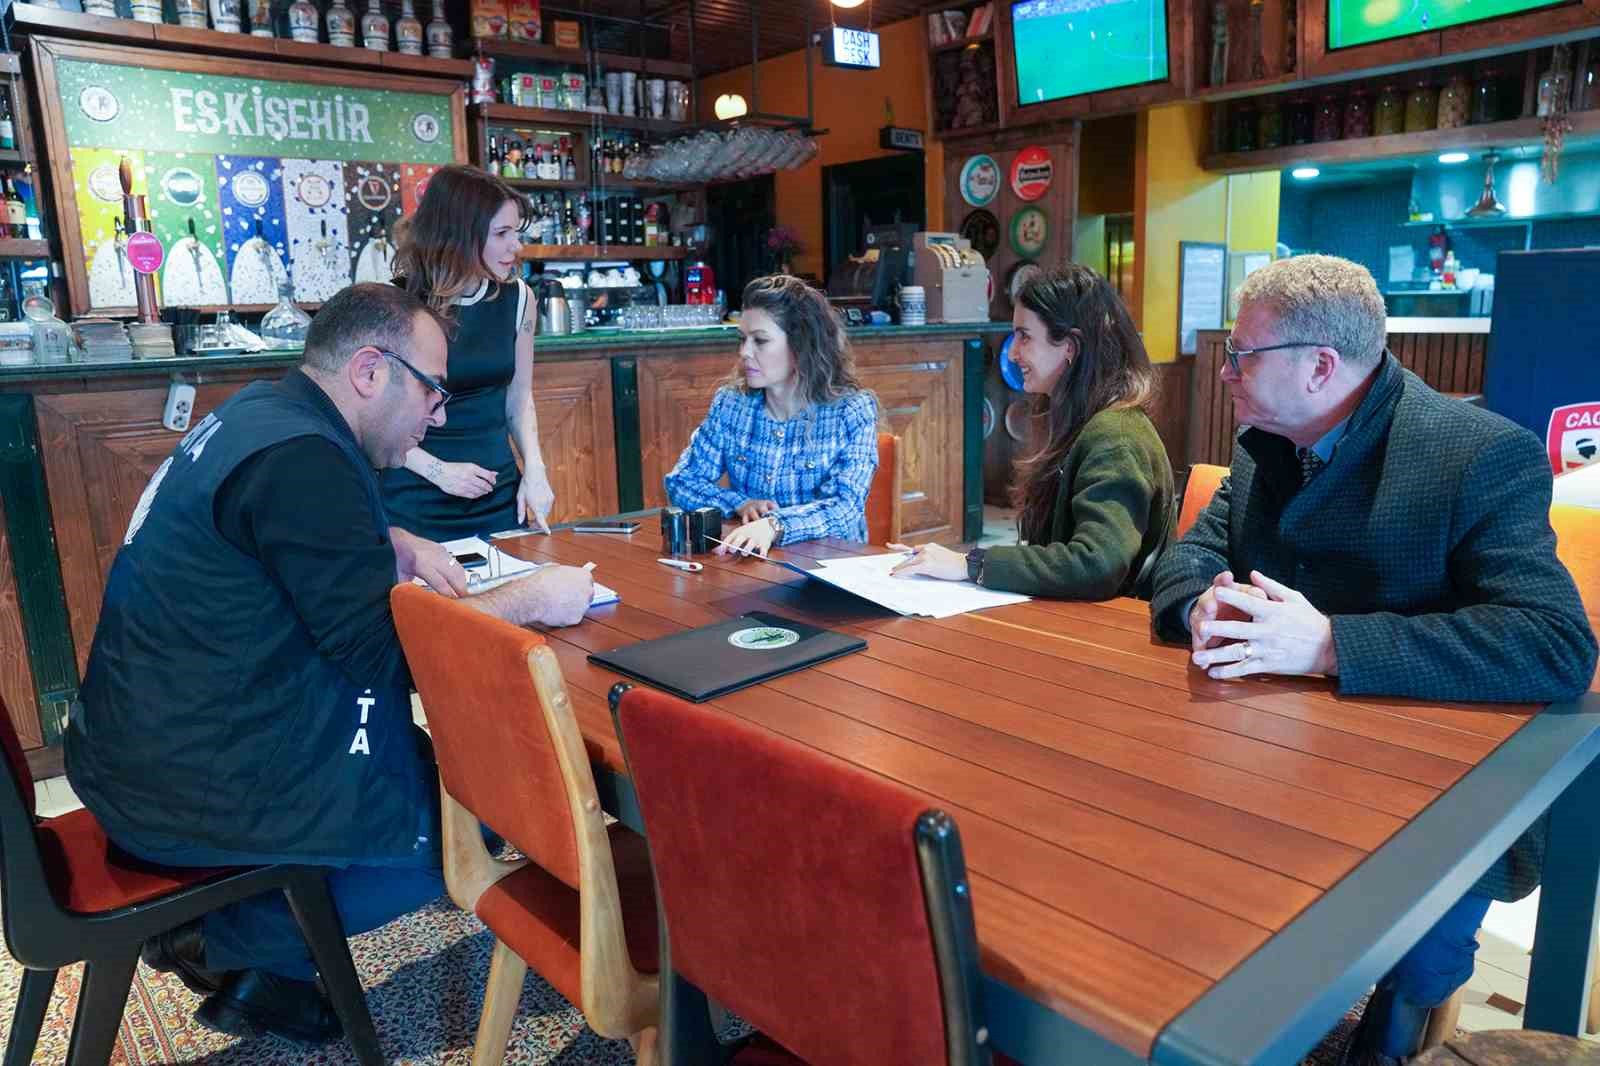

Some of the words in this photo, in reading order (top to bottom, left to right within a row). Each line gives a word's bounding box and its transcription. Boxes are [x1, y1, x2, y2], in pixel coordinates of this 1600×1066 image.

[842, 30, 870, 48] CASH
[842, 47, 871, 65] DESK
[169, 86, 375, 144] ESKİŞEHİR
[349, 688, 376, 755] TA
